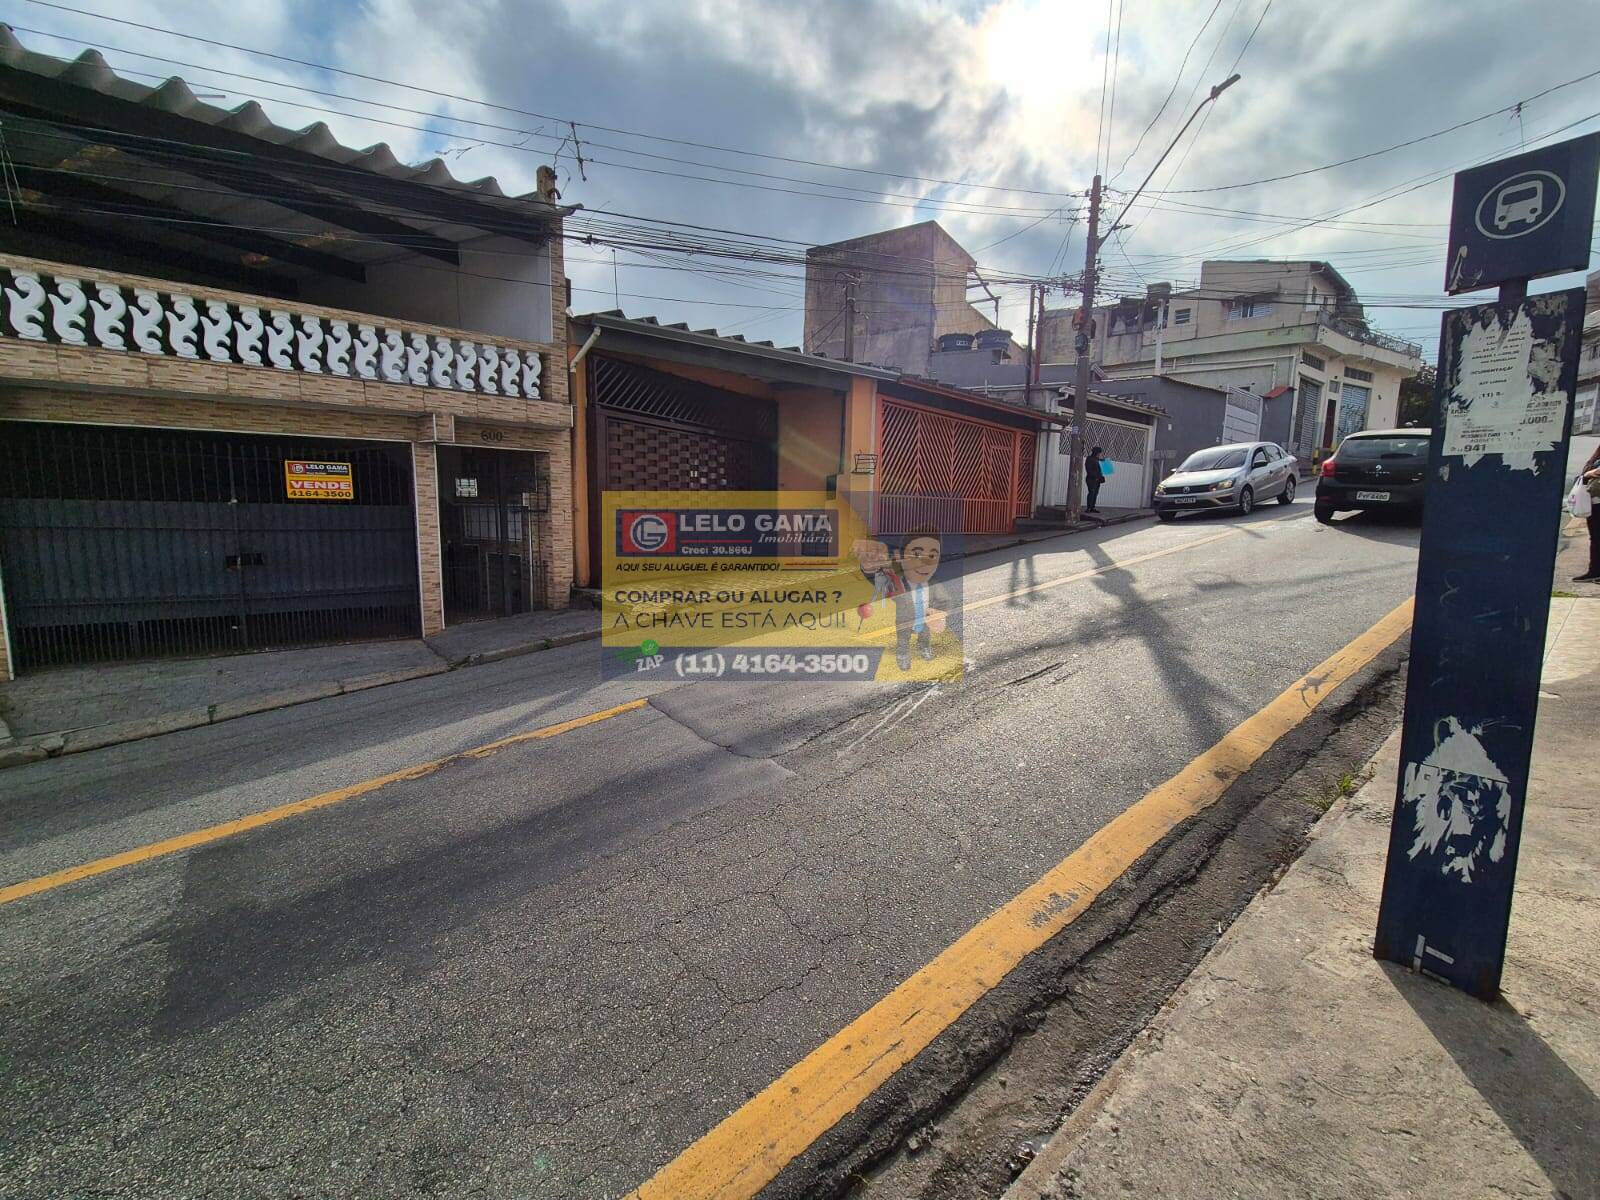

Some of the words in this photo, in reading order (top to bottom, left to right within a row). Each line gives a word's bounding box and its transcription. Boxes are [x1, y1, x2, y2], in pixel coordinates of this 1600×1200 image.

[481, 430, 503, 441] 600
[290, 480, 351, 489] VENDE
[290, 489, 351, 498] 4164-3500
